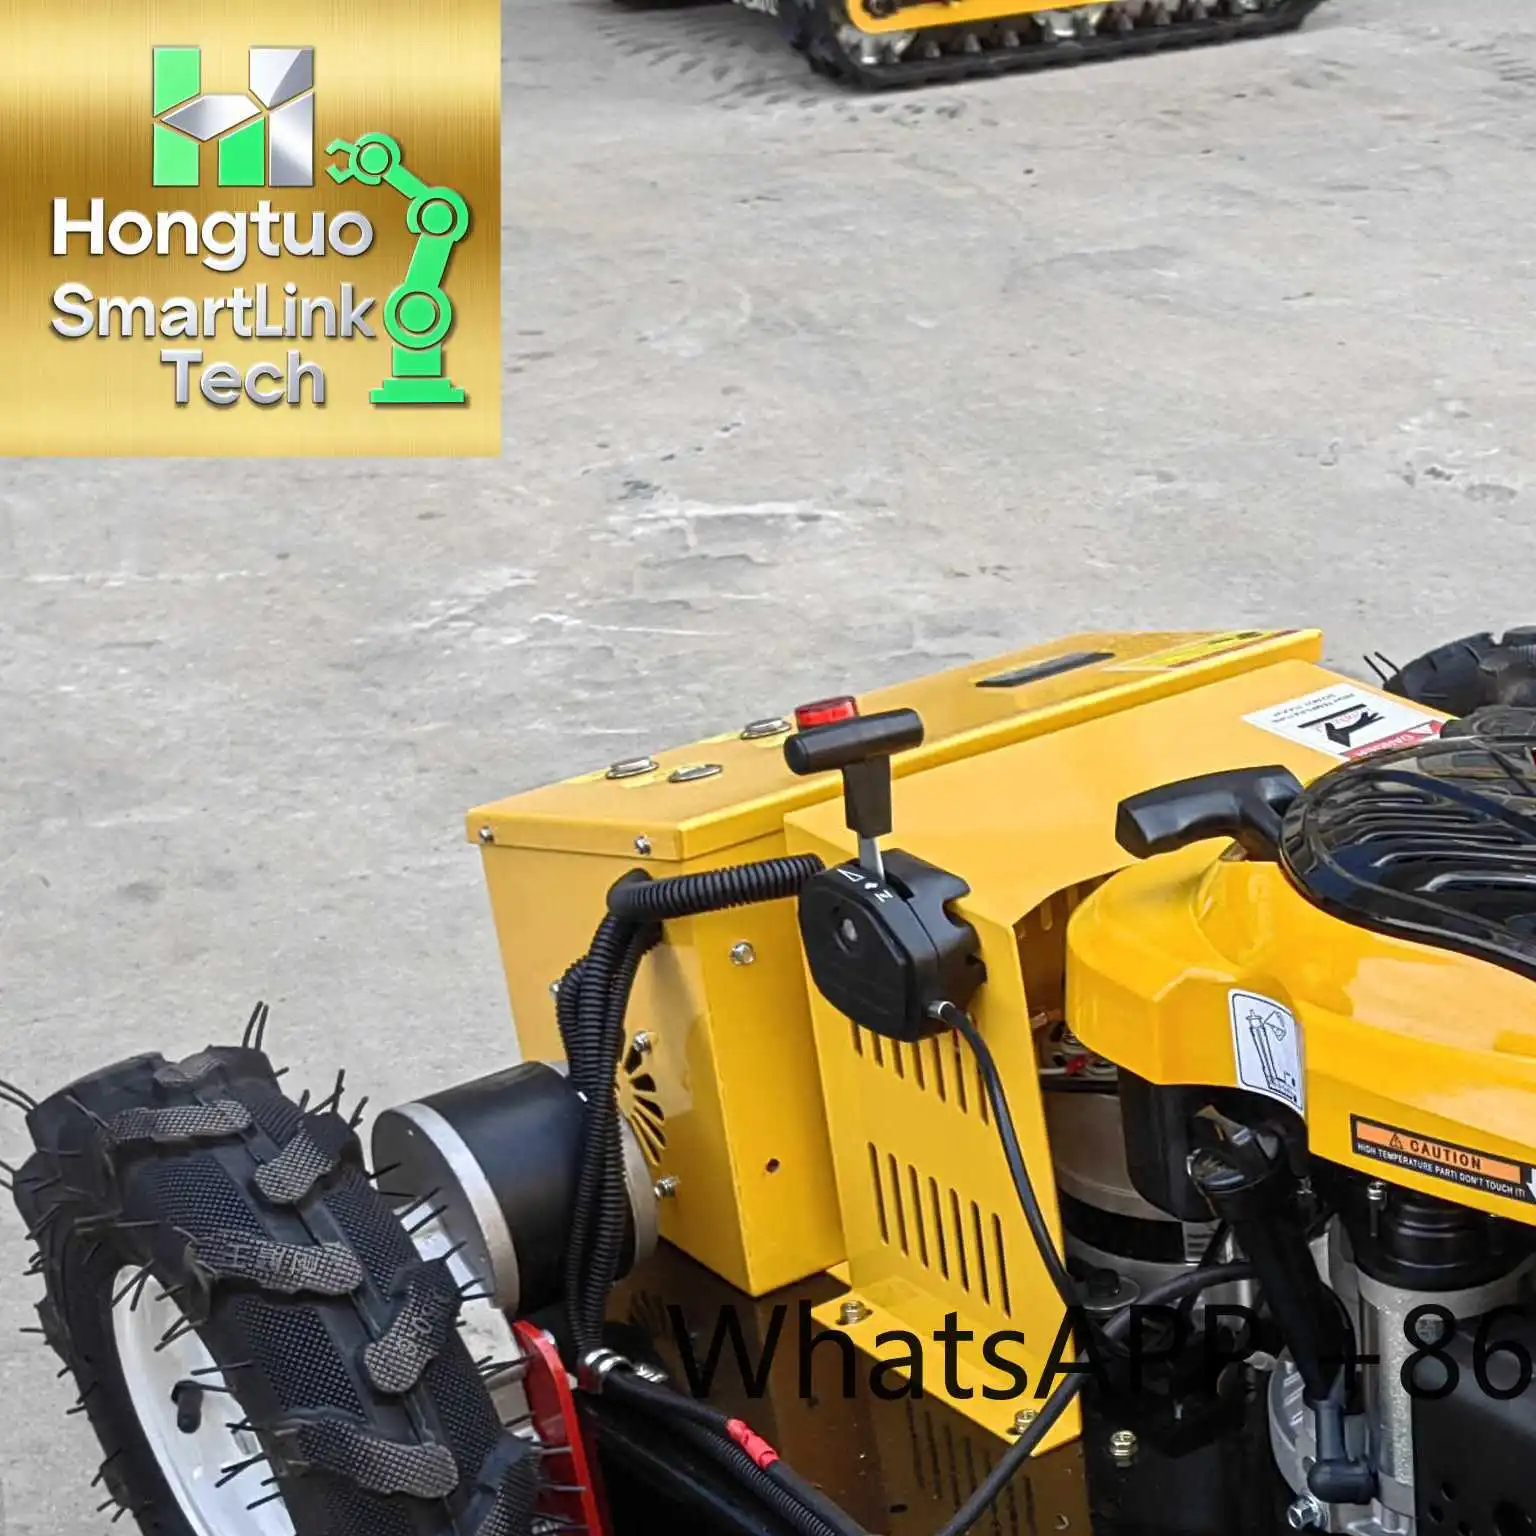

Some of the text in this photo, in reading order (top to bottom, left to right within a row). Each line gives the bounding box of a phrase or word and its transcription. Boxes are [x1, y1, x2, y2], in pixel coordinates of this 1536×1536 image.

[1357, 1142, 1377, 1156] HIGH
[1378, 1148, 1433, 1173] TEMPERATURE
[1459, 1172, 1484, 1187] DON'T
[1486, 1179, 1514, 1196] TOUCH
[1410, 1139, 1482, 1171] CAUTION
